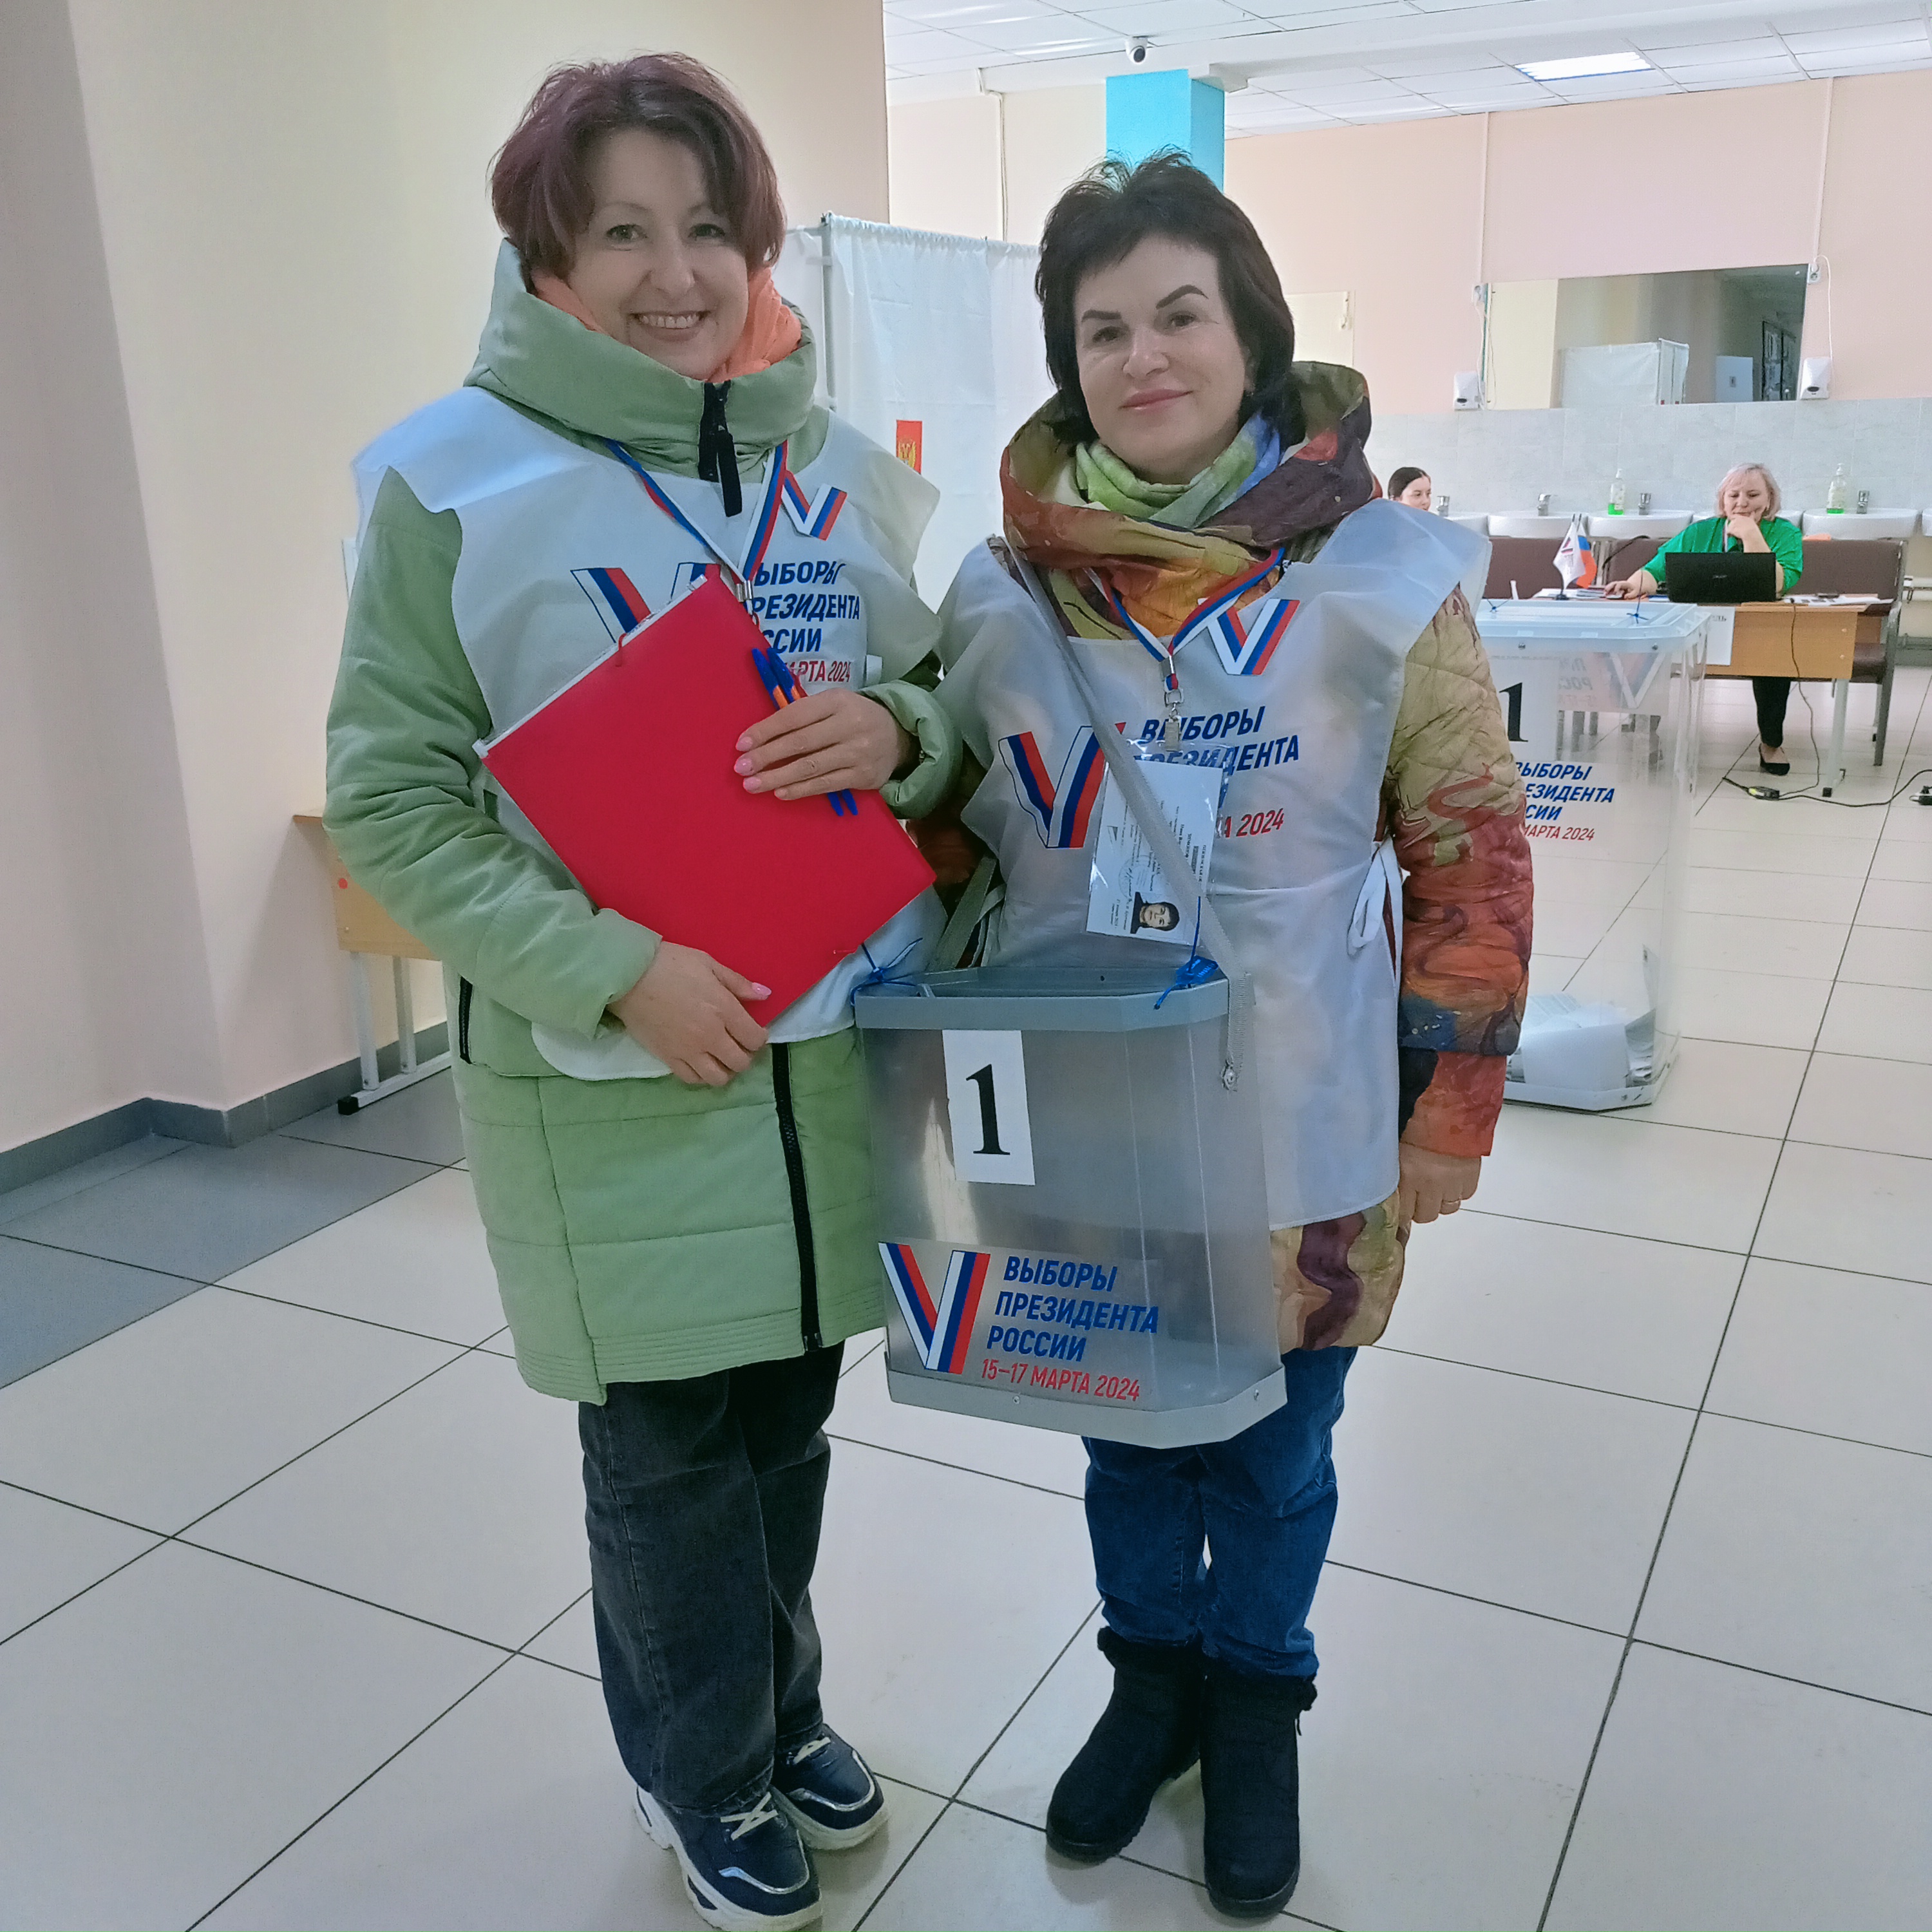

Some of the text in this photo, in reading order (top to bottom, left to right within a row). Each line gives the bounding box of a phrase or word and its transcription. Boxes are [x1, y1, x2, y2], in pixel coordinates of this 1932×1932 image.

[754, 561, 846, 587] ЫБОРЫ
[752, 593, 860, 622] РЕЗИДЕНТА
[762, 628, 822, 654] СИИ
[827, 660, 852, 683] 2024
[1499, 682, 1529, 743] 1
[1526, 783, 1615, 803] ЕЗИДЕНТА
[1236, 808, 1285, 838] 2024
[1525, 804, 1563, 821] СИИ
[1562, 827, 1596, 842] 2024
[966, 1063, 1010, 1155] 1
[1003, 1256, 1118, 1292] ВЫБОРЫ
[994, 1291, 1159, 1334] ПРЕЗИДЕНТА
[987, 1325, 1087, 1362] РОССИИ
[1030, 1365, 1091, 1396] МАРТА
[1094, 1374, 1141, 1401] 2024
